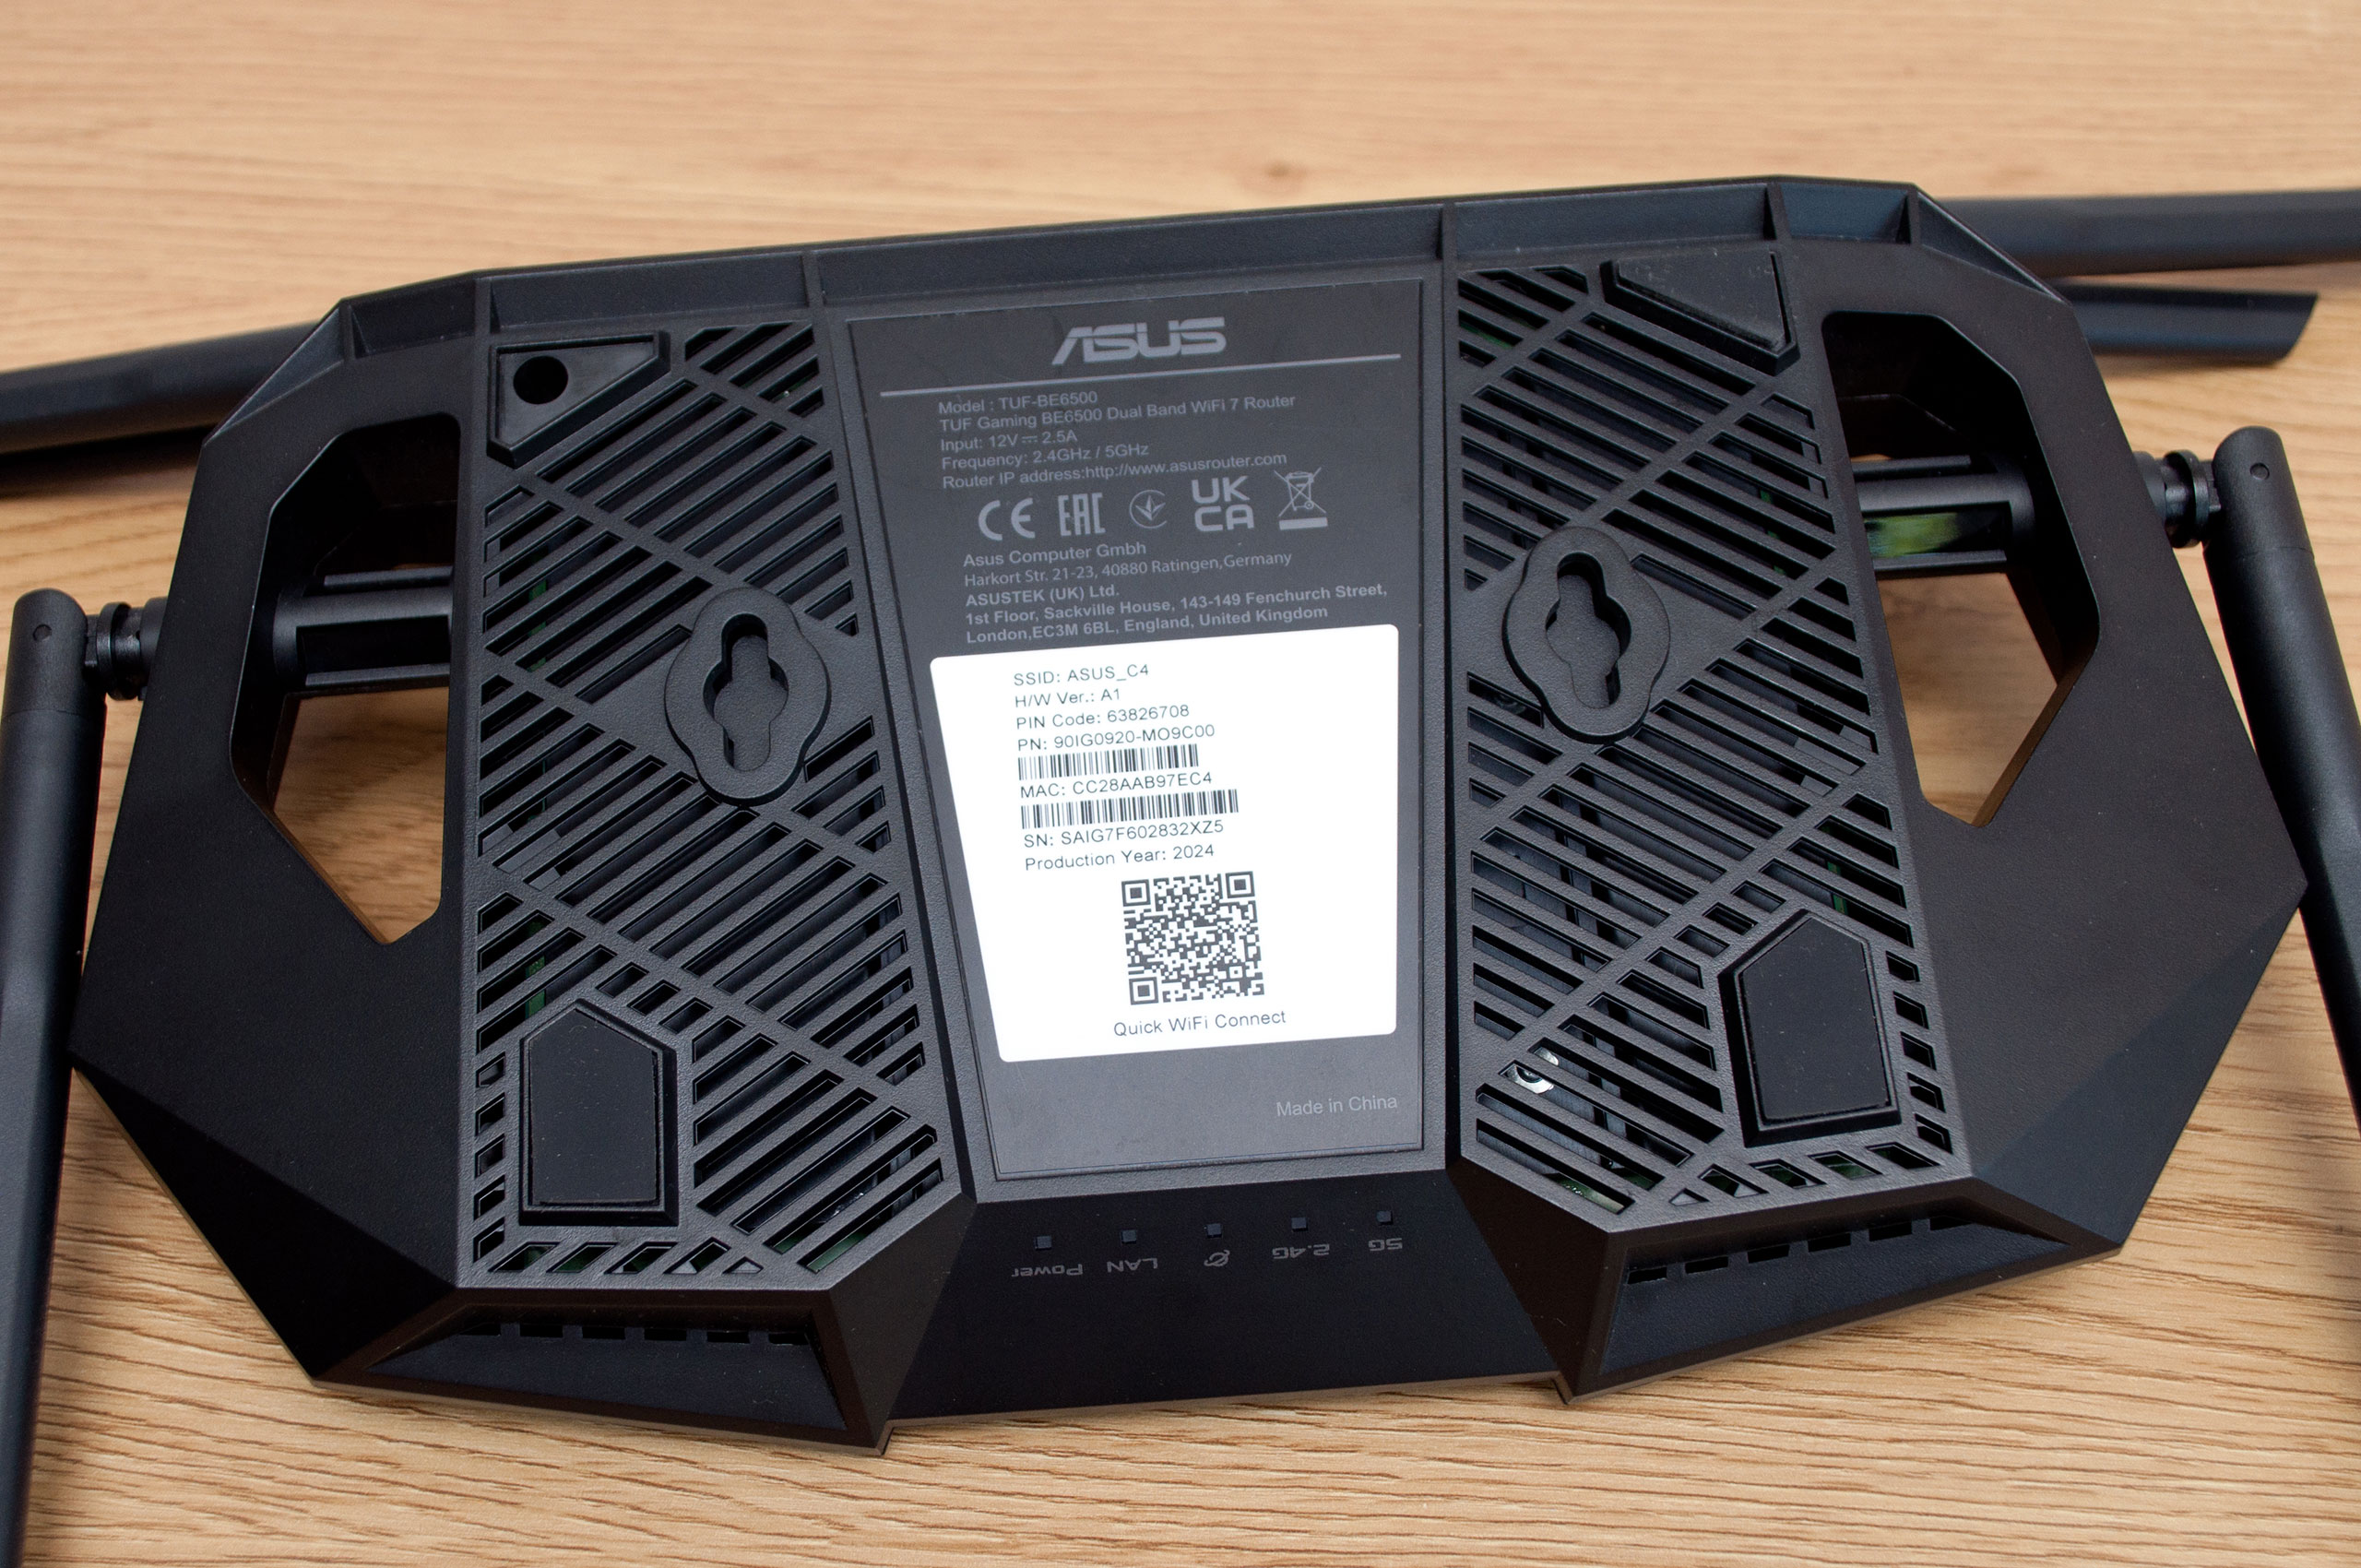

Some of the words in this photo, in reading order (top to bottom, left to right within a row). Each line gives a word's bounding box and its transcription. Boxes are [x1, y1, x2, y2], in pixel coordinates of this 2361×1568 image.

[1051, 316, 1227, 365] ASUS
[938, 398, 985, 415] Model
[998, 390, 1098, 410] TUF-BE6500
[939, 417, 972, 432] TUF
[977, 414, 1038, 430] Gaming
[1041, 408, 1103, 425] BE6500
[1106, 405, 1143, 421] Dual
[1146, 401, 1187, 418] Band
[1190, 398, 1226, 414] WiFi
[1229, 398, 1240, 410] 7
[1243, 395, 1296, 410] Router
[941, 436, 983, 454] Input:
[989, 434, 1019, 448] 12V
[1041, 429, 1078, 445] 2.5A
[942, 454, 1028, 470] Frequency:
[1032, 447, 1092, 464] 2.4GHz
[1105, 443, 1149, 458] 5GHz
[943, 474, 995, 489] Router
[999, 471, 1015, 485] IP
[1191, 475, 1251, 503] UK
[1194, 505, 1255, 532] CA
[963, 553, 1004, 567] Asus
[1008, 547, 1092, 564] Computer
[1096, 541, 1146, 558] Gmbh
[964, 571, 1021, 588] Harkort
[1025, 569, 1049, 583] Str.
[1052, 565, 1098, 581] 21-23,
[1101, 561, 1148, 576] 40880
[966, 588, 1046, 607] ASUSTEK
[1050, 586, 1085, 604] (UK)
[1089, 584, 1120, 599] Ltd.
[966, 612, 990, 625] 1st
[993, 610, 1039, 624] Floor,
[1044, 602, 1115, 620] Sackville
[1120, 600, 1176, 614] House,
[1180, 593, 1241, 610] 143-149
[1245, 587, 1331, 605] Fenchurch
[1335, 583, 1387, 599] Street,
[1083, 621, 1120, 635] 6BL,
[1123, 614, 1194, 634] England,
[1199, 610, 1252, 626] United
[1255, 606, 1328, 624] Kingdom
[1014, 671, 1061, 686] SSID:
[1067, 663, 1149, 683] ASUS_C4
[1014, 693, 1051, 708] H/W
[1056, 692, 1095, 705] Ver.:
[1100, 688, 1120, 702] A1
[1016, 716, 1046, 730] PIN
[1051, 713, 1101, 728] Code:
[1107, 704, 1190, 723] 63826708
[1017, 738, 1047, 752] PN:
[1020, 782, 1065, 799] MAC:
[1073, 771, 1212, 795] CC28AAB97EC4
[1024, 833, 1053, 849] SN:
[1025, 854, 1115, 871] Production
[1121, 849, 1167, 863] Year:
[1172, 844, 1215, 860] 2024
[1113, 1019, 1163, 1037] Quick
[1168, 1016, 1208, 1032] WiFi
[1215, 1010, 1287, 1029] Connect
[1275, 1099, 1323, 1117] Made
[1328, 1098, 1344, 1113] in
[1348, 1094, 1398, 1111] China
[1272, 1243, 1330, 1260] 2.4G
[1368, 1237, 1403, 1252] 5G
[1011, 1263, 1084, 1277] Power
[1106, 1257, 1158, 1273] LAN
